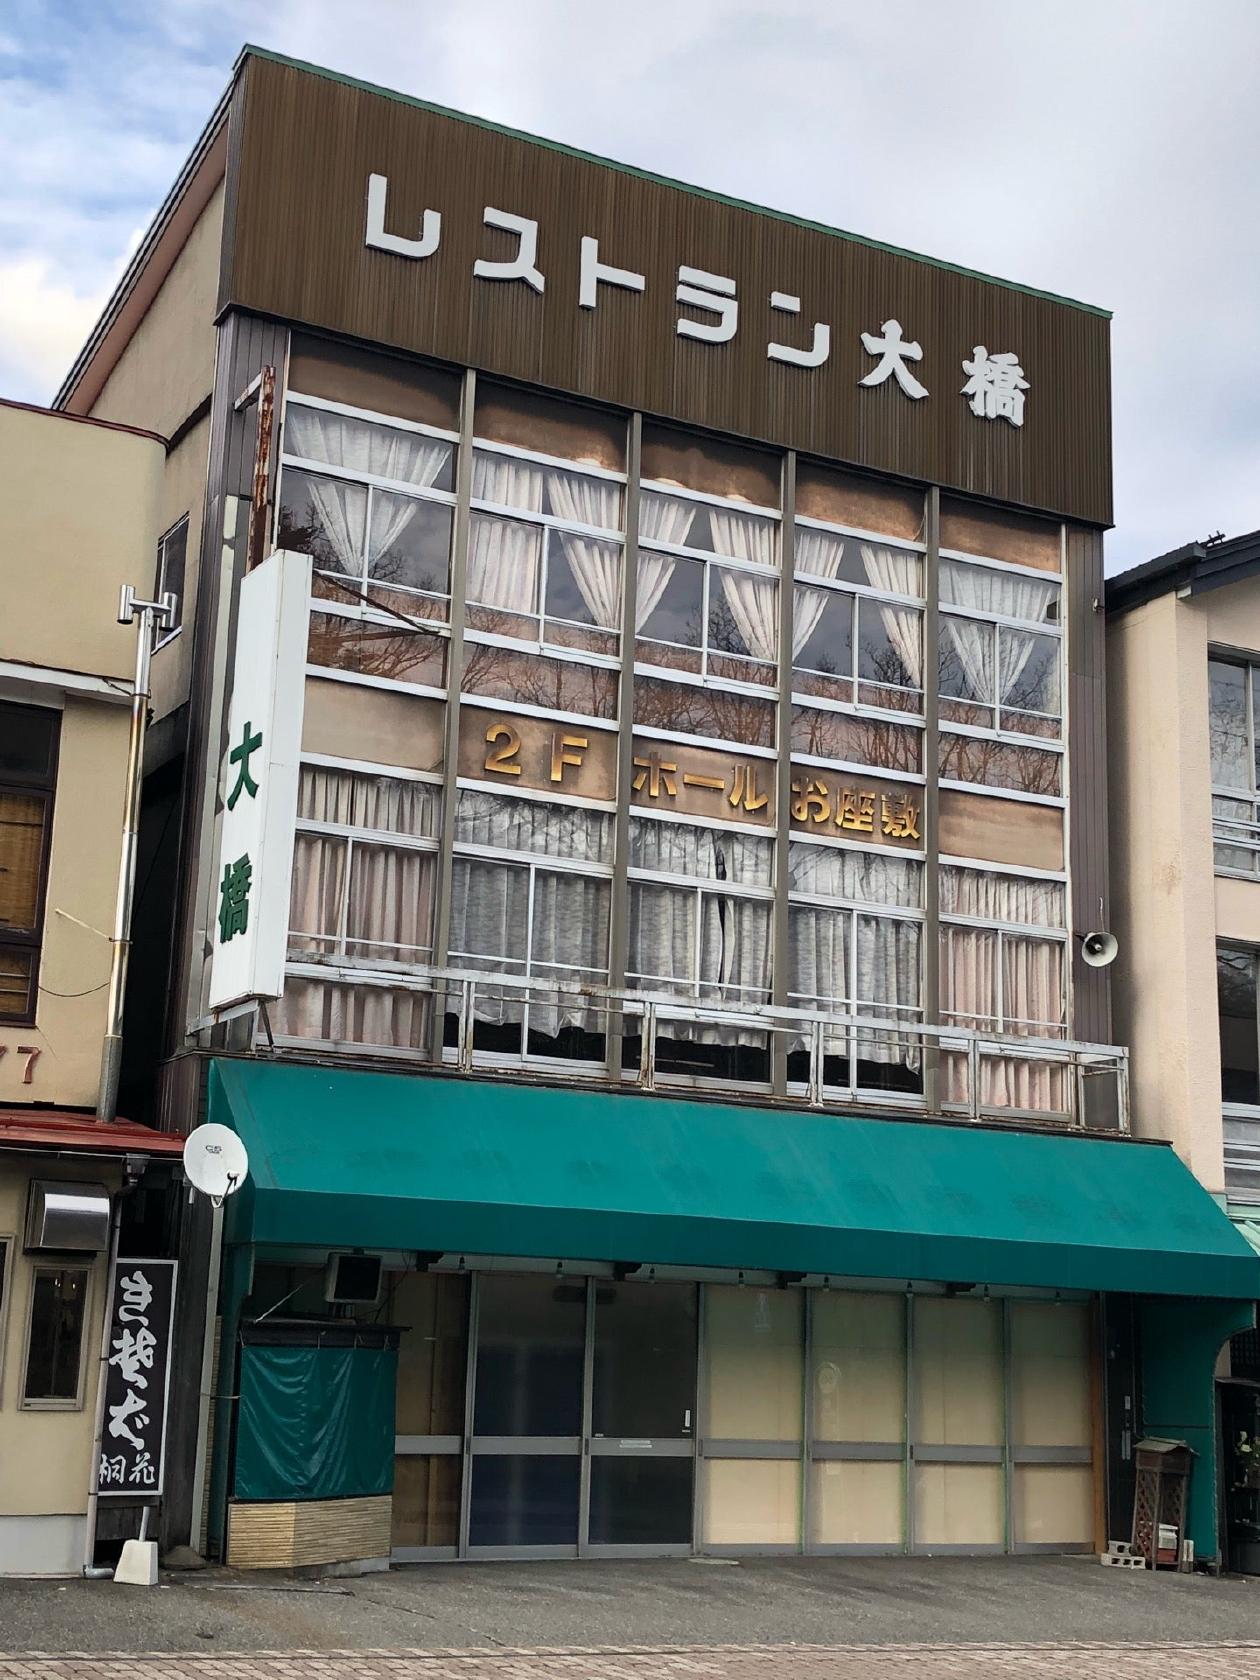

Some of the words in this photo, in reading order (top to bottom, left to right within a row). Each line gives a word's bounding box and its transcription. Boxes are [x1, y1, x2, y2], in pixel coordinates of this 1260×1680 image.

[218, 721, 262, 944] 大橋
[633, 751, 769, 812] ホール
[790, 778, 921, 841] お座敷
